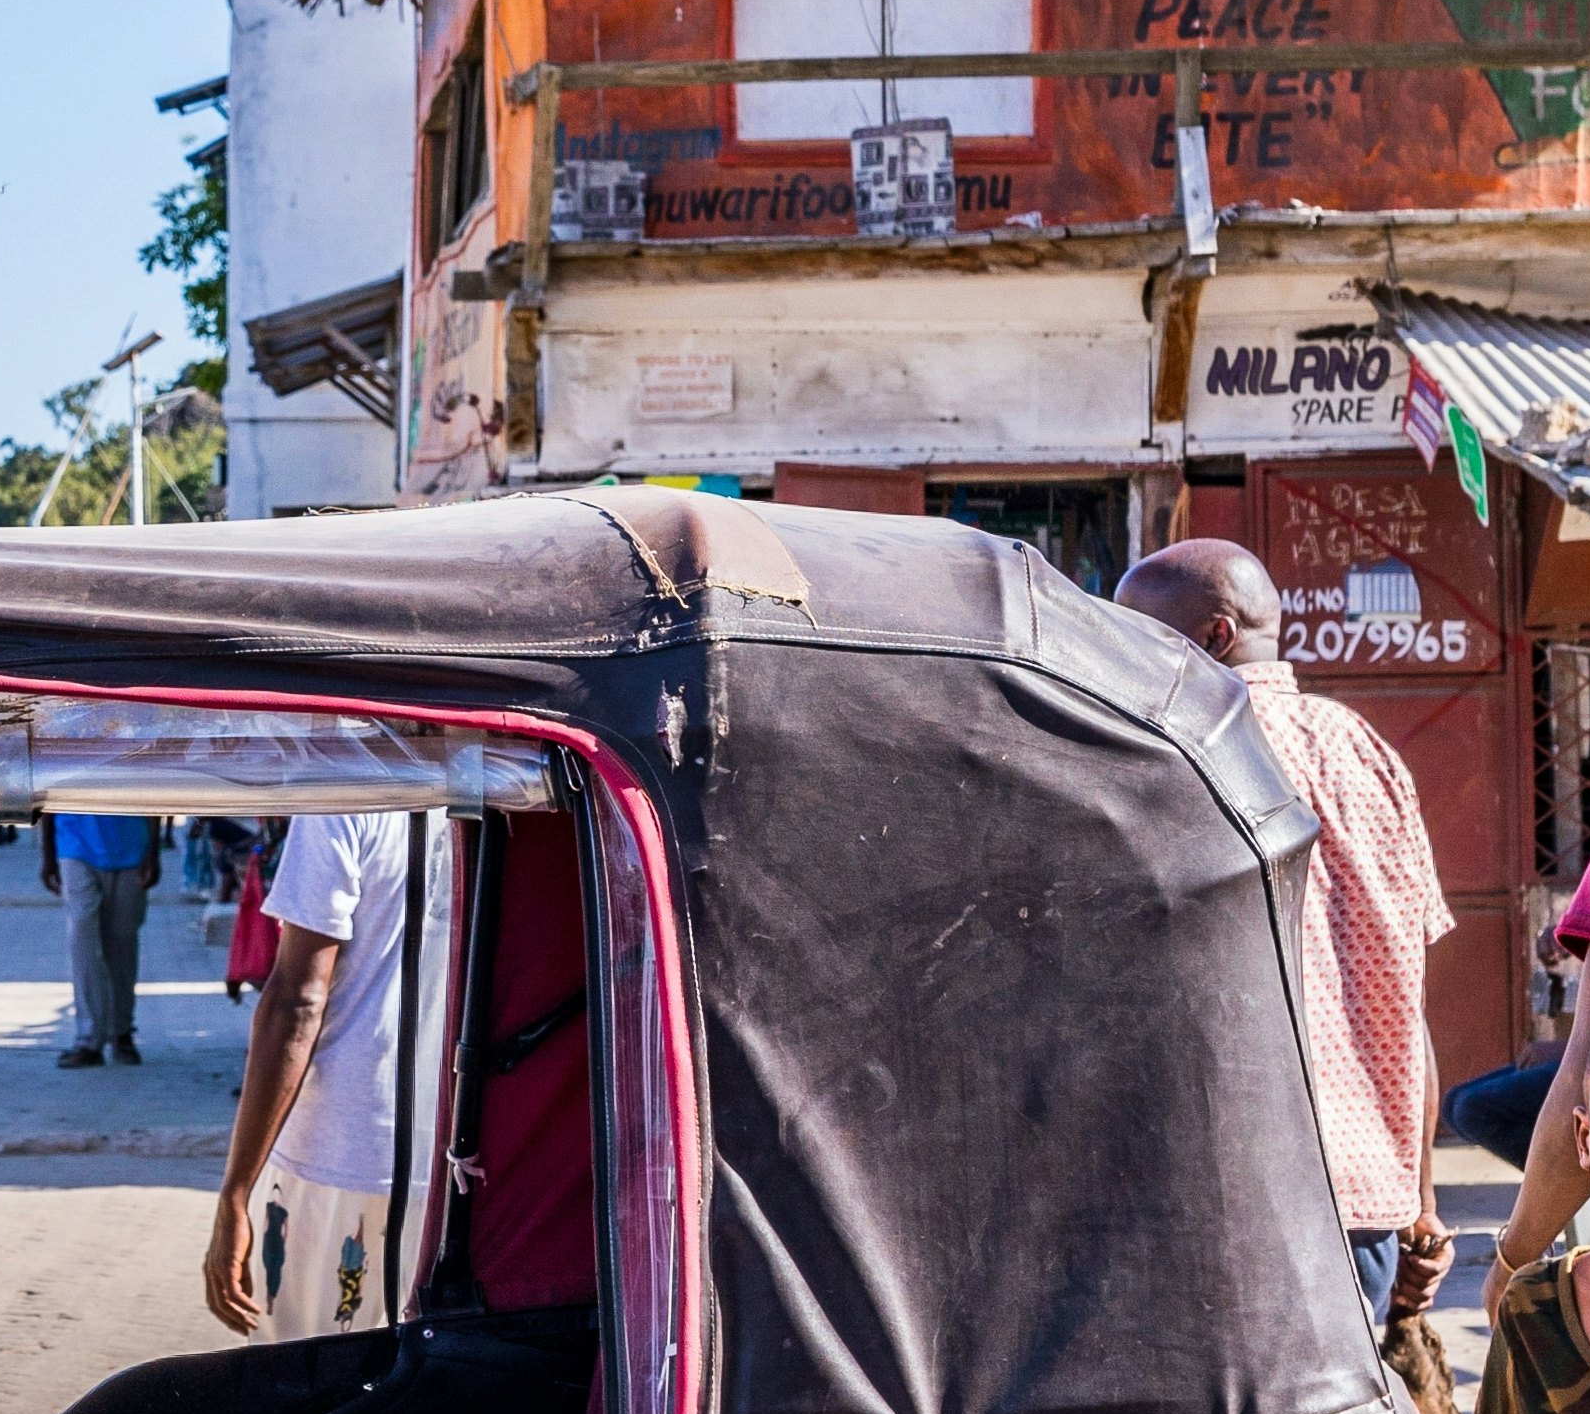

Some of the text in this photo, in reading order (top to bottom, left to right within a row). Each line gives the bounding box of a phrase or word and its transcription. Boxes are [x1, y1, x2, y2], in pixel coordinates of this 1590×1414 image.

[1206, 345, 1391, 395] MILANO
[1292, 396, 1375, 425] SPARE
[1284, 620, 1467, 664] 2079965
